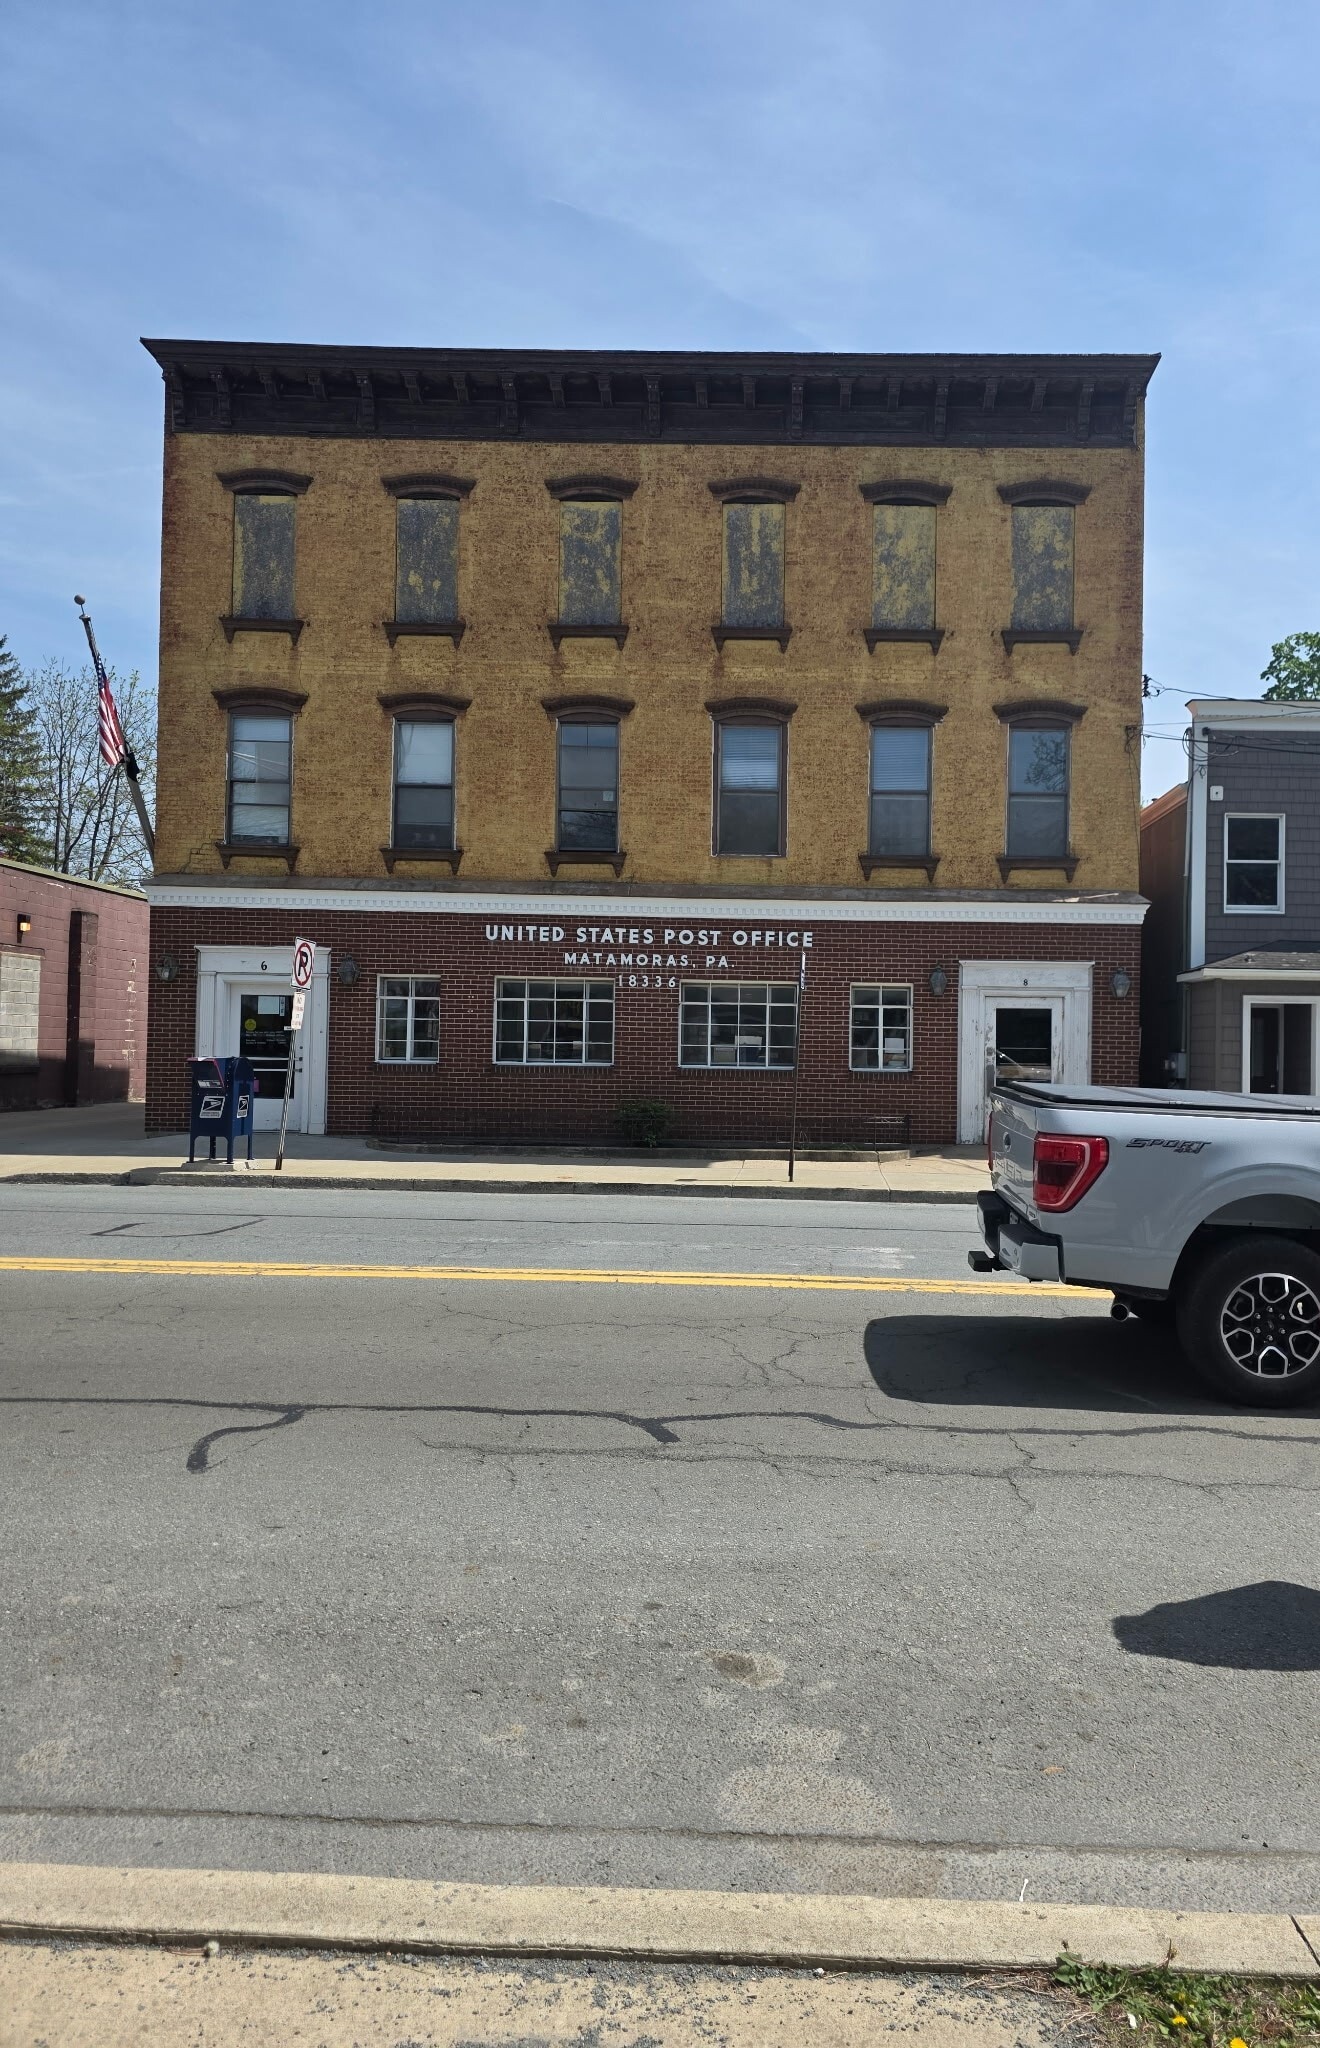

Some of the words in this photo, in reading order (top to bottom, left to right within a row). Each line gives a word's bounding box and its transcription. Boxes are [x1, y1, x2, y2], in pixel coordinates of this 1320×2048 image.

[485, 924, 565, 942] UNITED
[576, 926, 654, 944] STATES
[664, 929, 721, 946] POST
[732, 930, 813, 948] OFFICE
[260, 961, 268, 971] 6
[564, 952, 697, 968] MATAMORAS,
[706, 955, 736, 968] PA.
[618, 974, 676, 988] 18336
[1023, 978, 1029, 986] 8
[1126, 1138, 1212, 1151] SPORT
